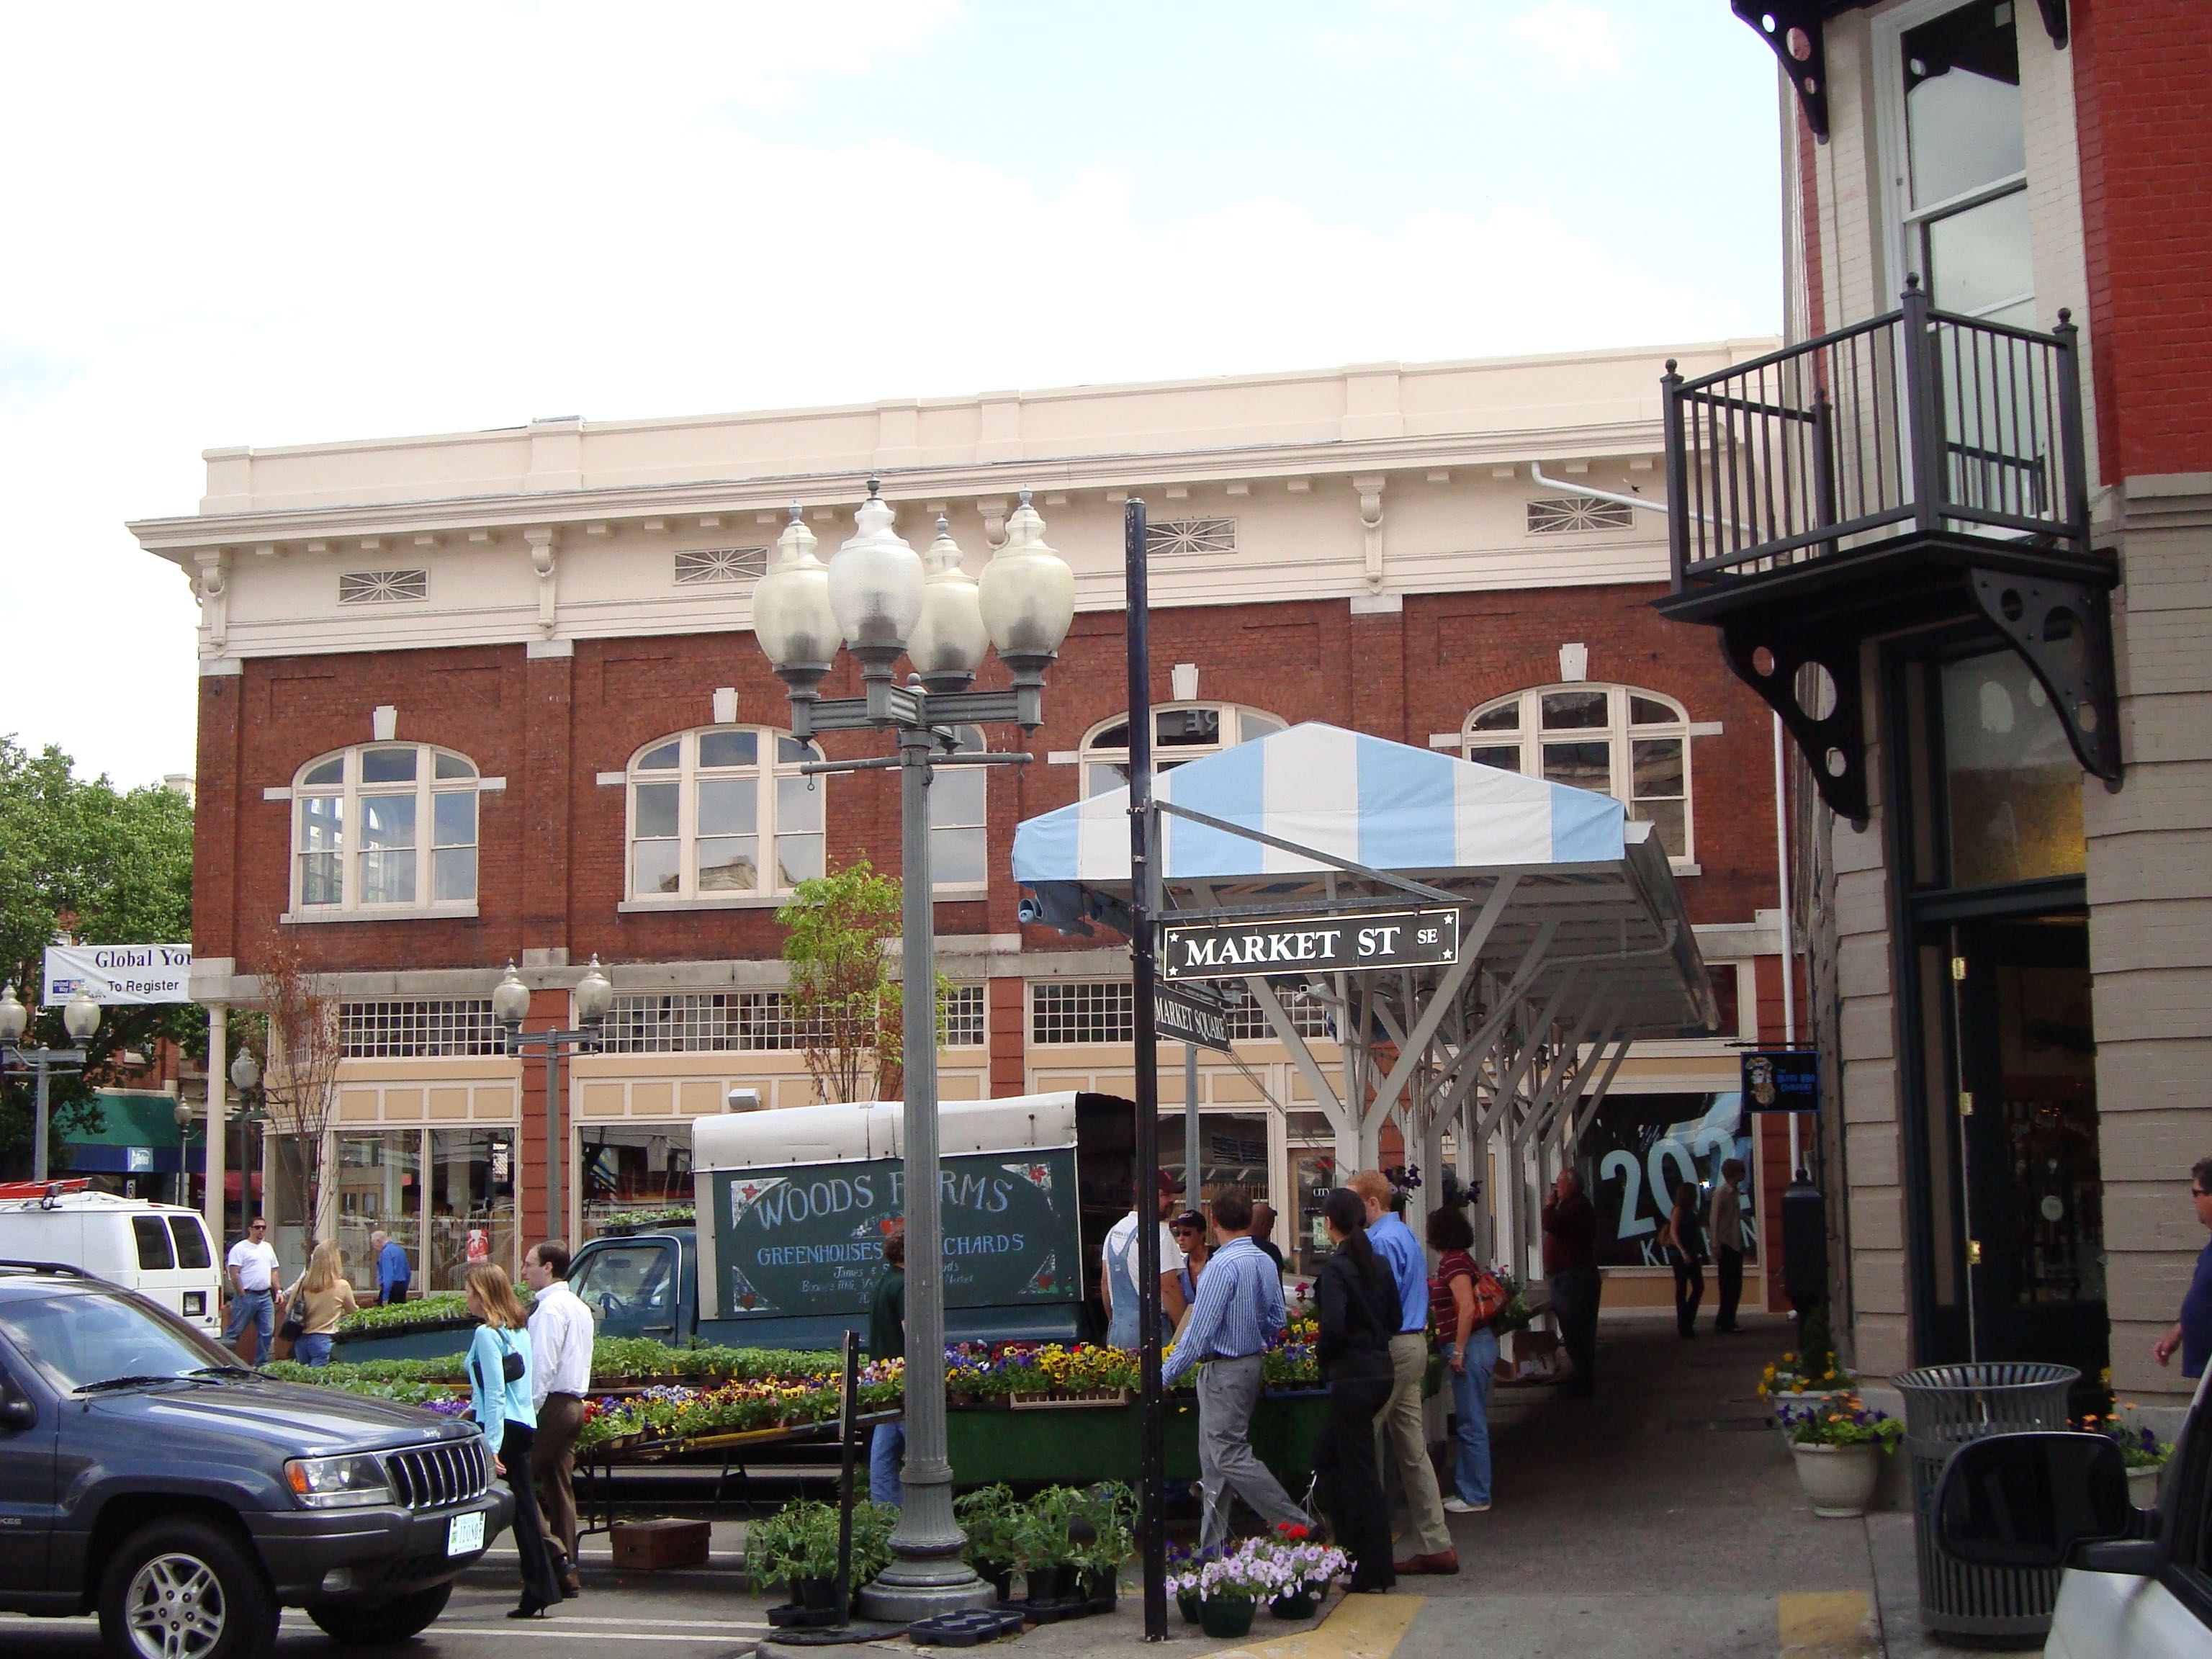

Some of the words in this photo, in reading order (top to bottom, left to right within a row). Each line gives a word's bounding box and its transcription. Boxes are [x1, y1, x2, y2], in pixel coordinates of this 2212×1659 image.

[96, 949, 153, 968] Global
[1184, 930, 1341, 966] MARKET
[1357, 926, 1401, 956] ST
[1417, 929, 1439, 945] SE
[107, 981, 122, 992] To
[126, 979, 180, 994] Register
[1154, 995, 1194, 1032] MARKET
[1194, 1009, 1227, 1042] SQUARE
[754, 1175, 873, 1231] WOODS
[889, 1170, 1013, 1213] FRMS
[757, 1241, 884, 1266] GREENHOUSES
